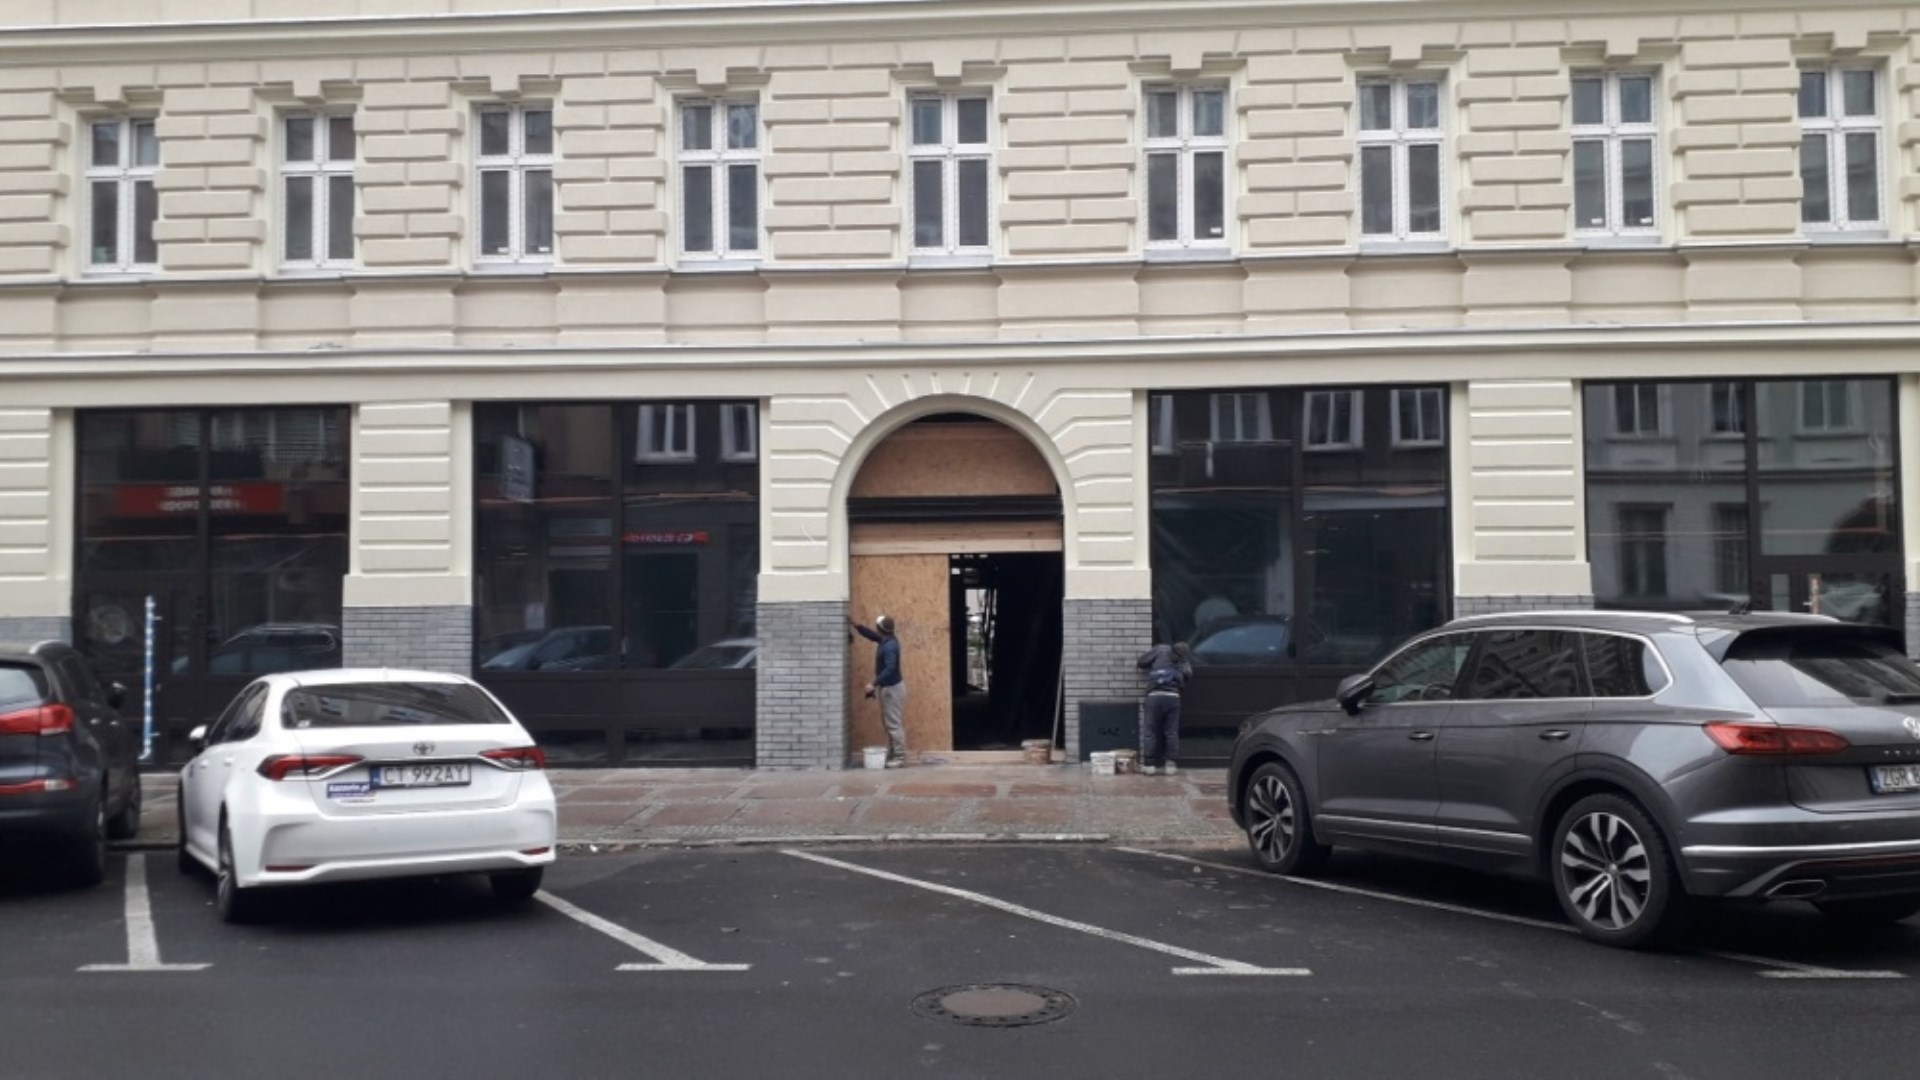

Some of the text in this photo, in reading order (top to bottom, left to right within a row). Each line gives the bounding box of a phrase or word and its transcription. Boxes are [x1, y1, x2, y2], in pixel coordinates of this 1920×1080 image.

[383, 764, 465, 785] CT 992AY
[1879, 767, 1910, 787] ZGR
